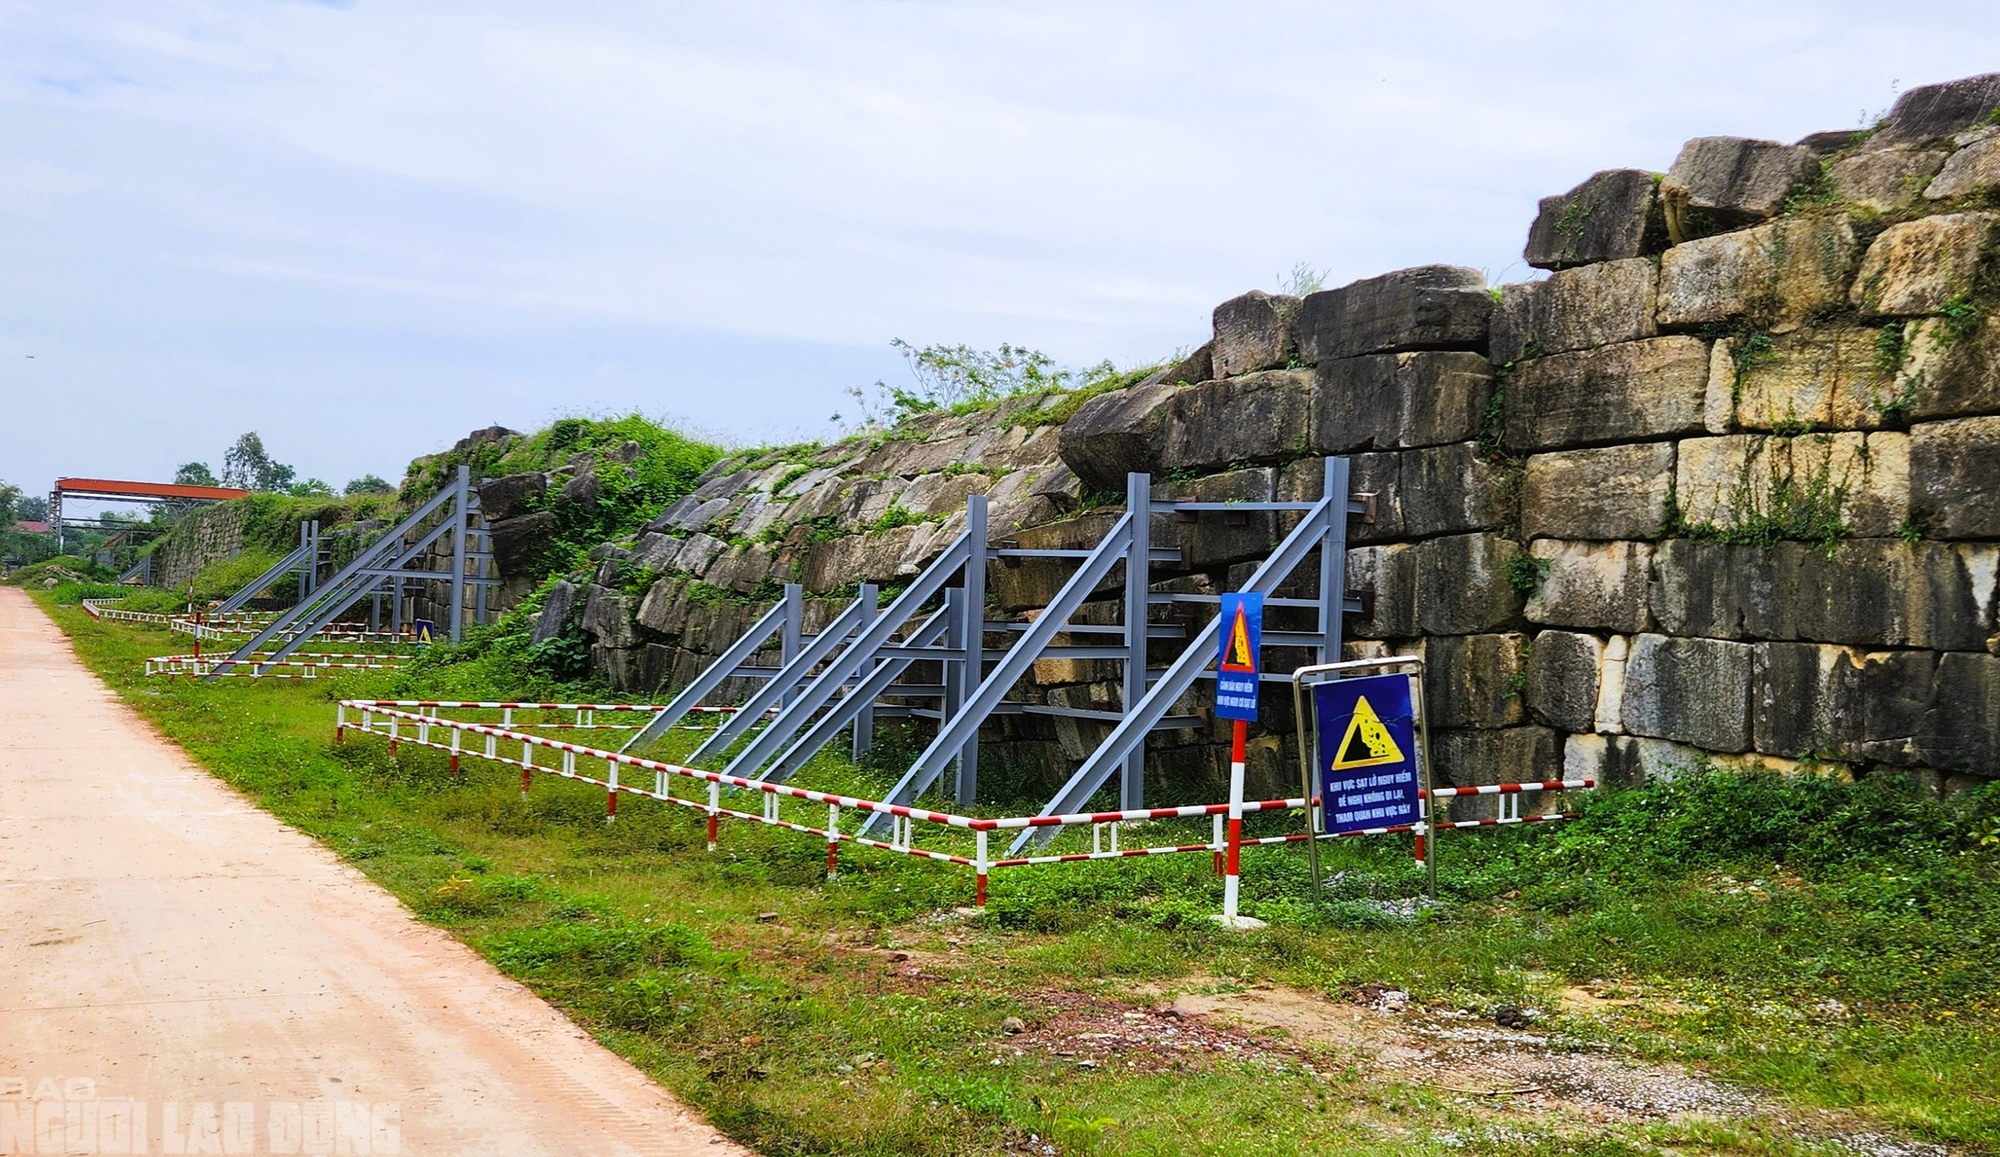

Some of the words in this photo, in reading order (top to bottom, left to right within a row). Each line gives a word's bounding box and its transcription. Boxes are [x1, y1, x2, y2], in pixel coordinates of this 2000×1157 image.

[1330, 781, 1341, 792] KHU
[1343, 780, 1355, 791] VỰC
[1356, 778, 1367, 790] SẠT
[1369, 773, 1377, 787] LỞ
[1377, 774, 1394, 786] NGUY
[1347, 795, 1363, 806] NGHỊ
[1364, 791, 1385, 803] KHÔNG
[1385, 791, 1393, 800] ĐI
[1335, 812, 1353, 823] THAM
[1354, 810, 1371, 822] QUAN
[1371, 807, 1385, 819] KHU
[1385, 806, 1397, 818] VỰC
[1398, 803, 1411, 815] NÀY
